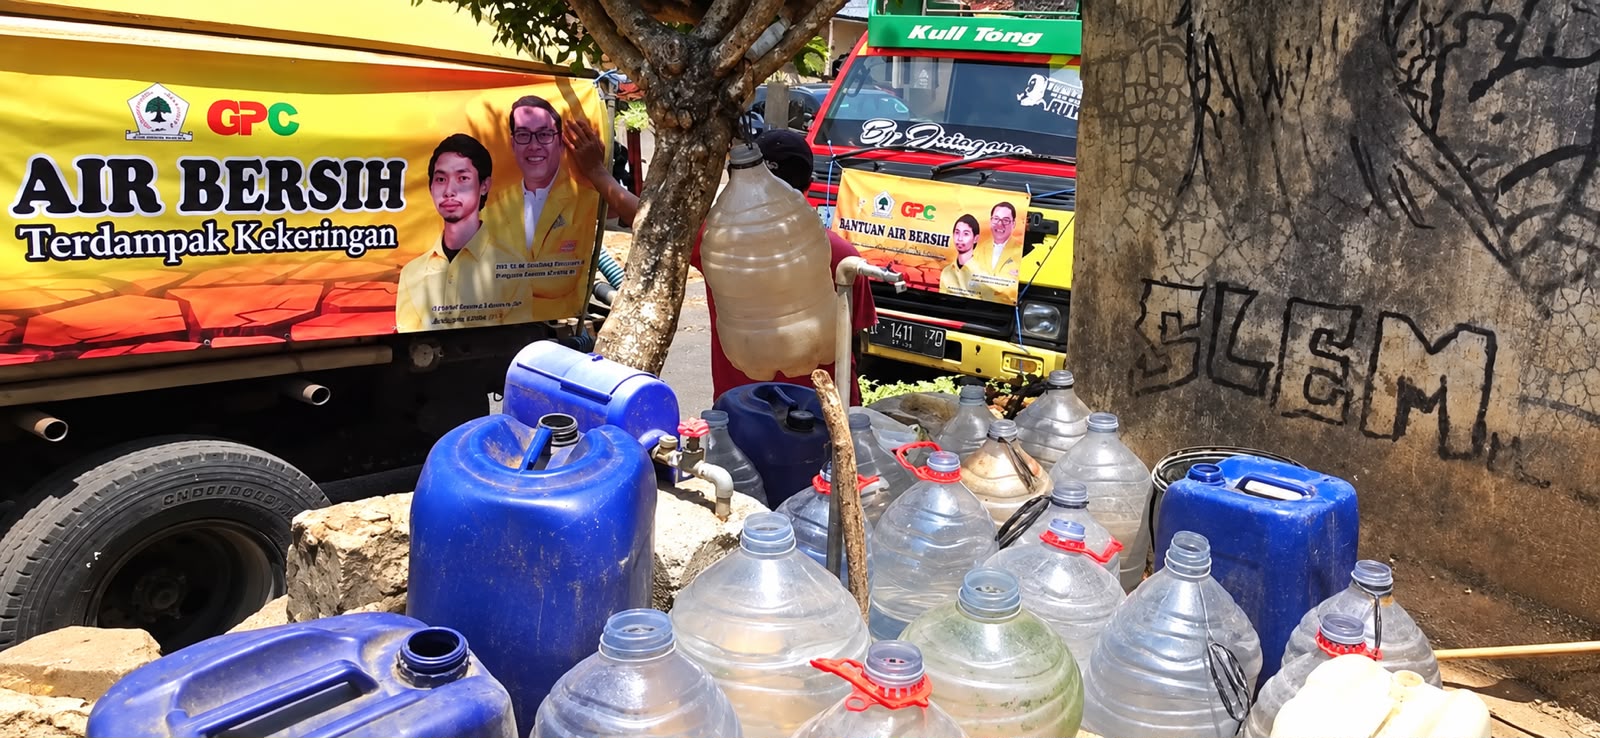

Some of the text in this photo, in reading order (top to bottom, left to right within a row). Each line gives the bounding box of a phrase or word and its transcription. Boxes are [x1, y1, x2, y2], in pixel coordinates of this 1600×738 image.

[907, 24, 969, 41] Kull
[206, 99, 300, 137] GPC
[11, 155, 407, 217] AIR BERSIH
[901, 201, 937, 221] GPC
[17, 219, 398, 265] Terdampak Kekeringan
[839, 217, 951, 248] BANTUAN AIR BERSIH
[890, 322, 913, 341] 1411
